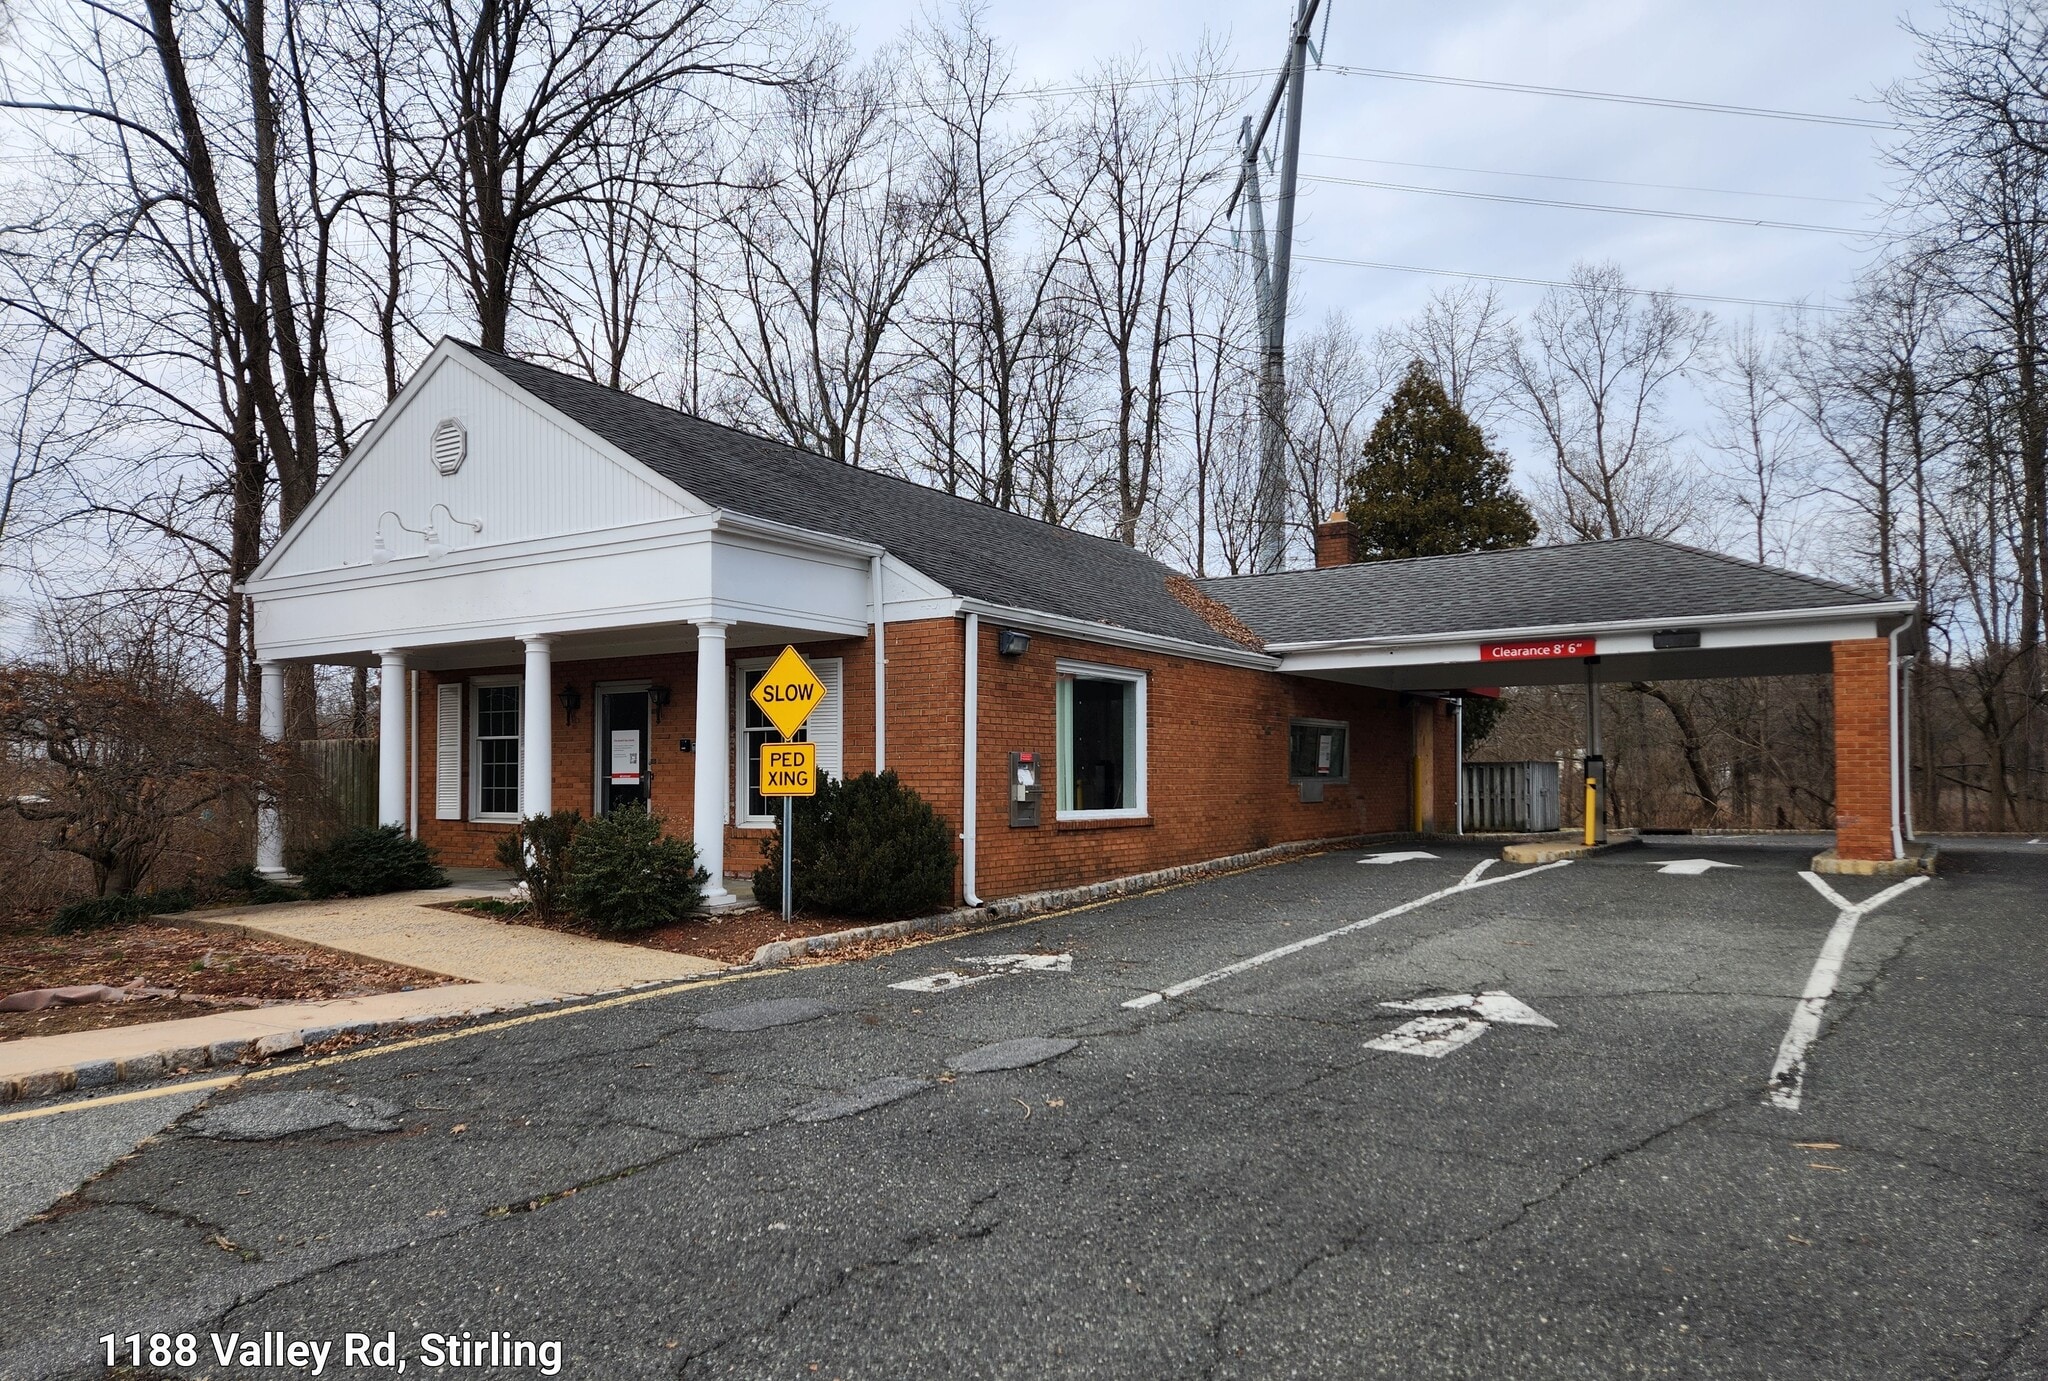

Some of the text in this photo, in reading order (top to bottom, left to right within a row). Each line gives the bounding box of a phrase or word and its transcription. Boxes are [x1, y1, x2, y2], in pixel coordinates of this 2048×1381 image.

[1492, 647, 1551, 657] Clearance
[763, 684, 814, 702] SLOW
[770, 752, 805, 767] PED
[768, 771, 808, 786] XING
